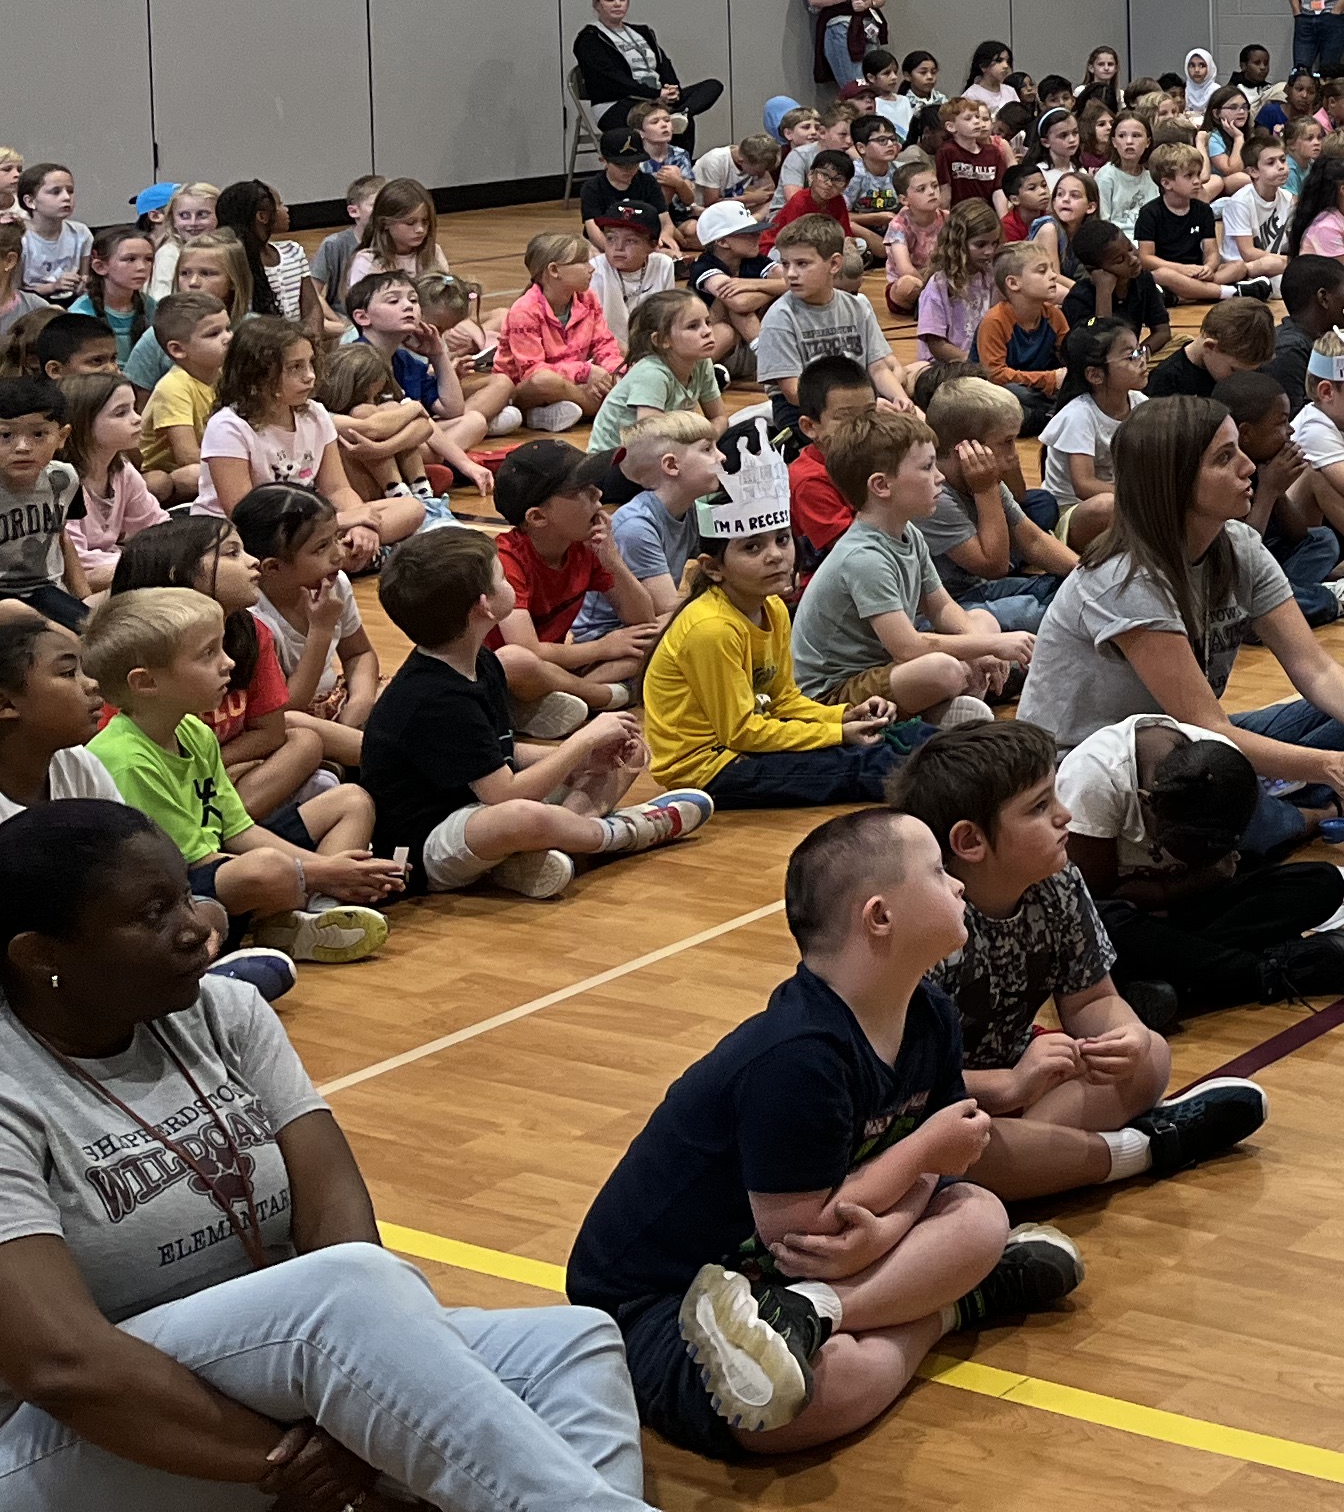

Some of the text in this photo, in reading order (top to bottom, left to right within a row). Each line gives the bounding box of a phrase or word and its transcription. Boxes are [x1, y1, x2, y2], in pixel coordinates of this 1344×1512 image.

[0, 502, 65, 545] ORDAN
[713, 519, 731, 534] I'M
[734, 519, 745, 533] A
